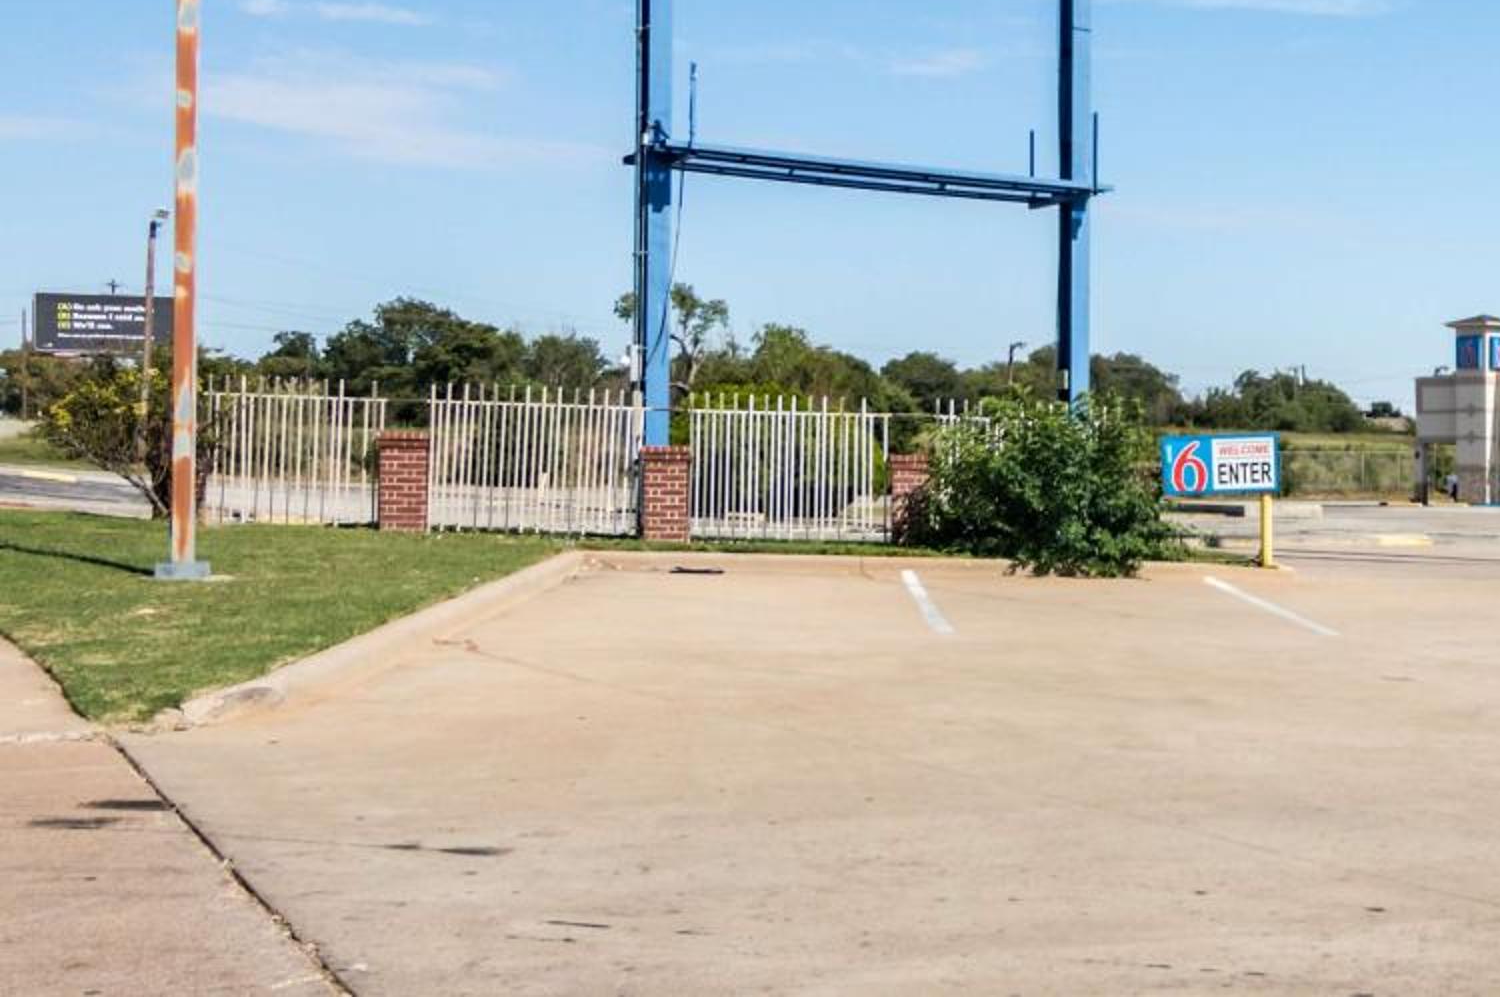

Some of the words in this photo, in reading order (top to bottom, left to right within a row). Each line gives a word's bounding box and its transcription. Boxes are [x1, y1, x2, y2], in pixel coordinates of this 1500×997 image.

[1219, 444, 1269, 456] WELCOME
[1172, 440, 1208, 491] 6
[1217, 461, 1272, 485] ENTER
